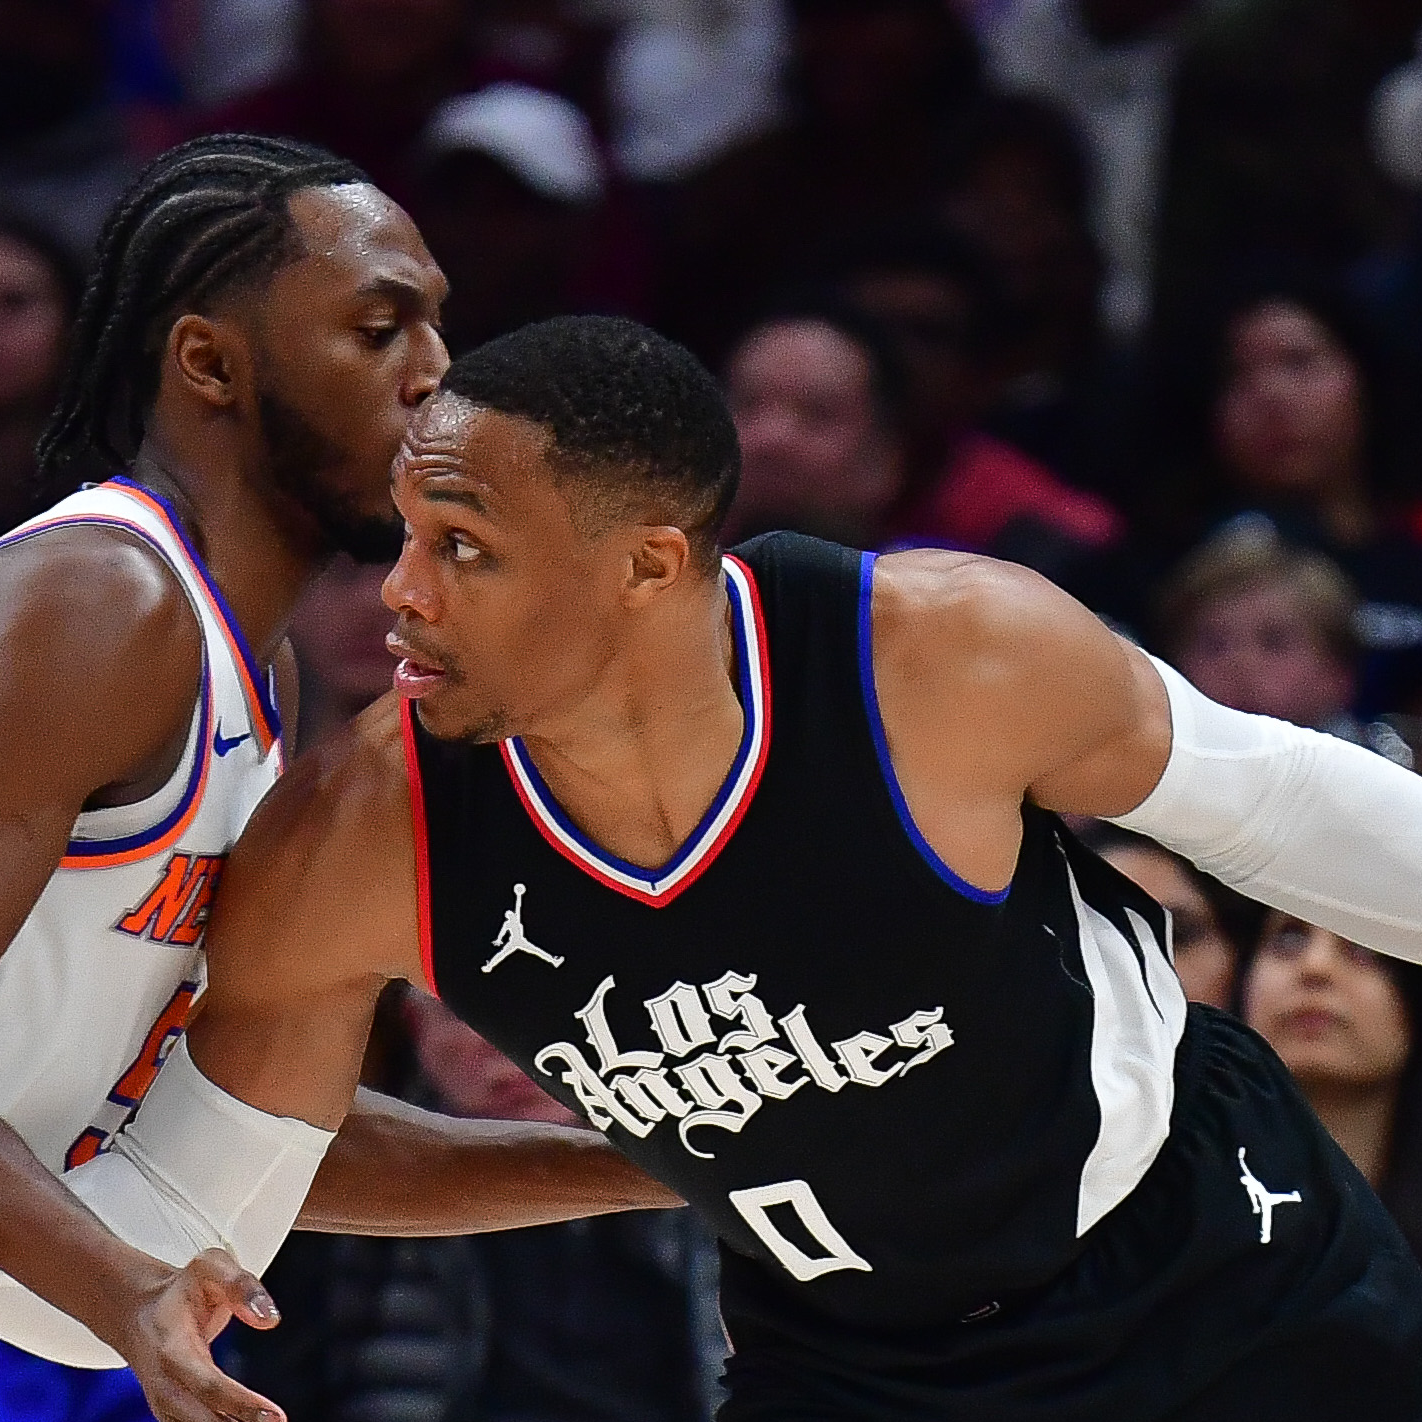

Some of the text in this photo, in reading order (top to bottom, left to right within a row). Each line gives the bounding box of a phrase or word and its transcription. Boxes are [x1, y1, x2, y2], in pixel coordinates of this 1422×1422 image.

[574, 969, 780, 1077] Los
[534, 1004, 955, 1159] Angeles
[728, 1179, 873, 1282] 0
